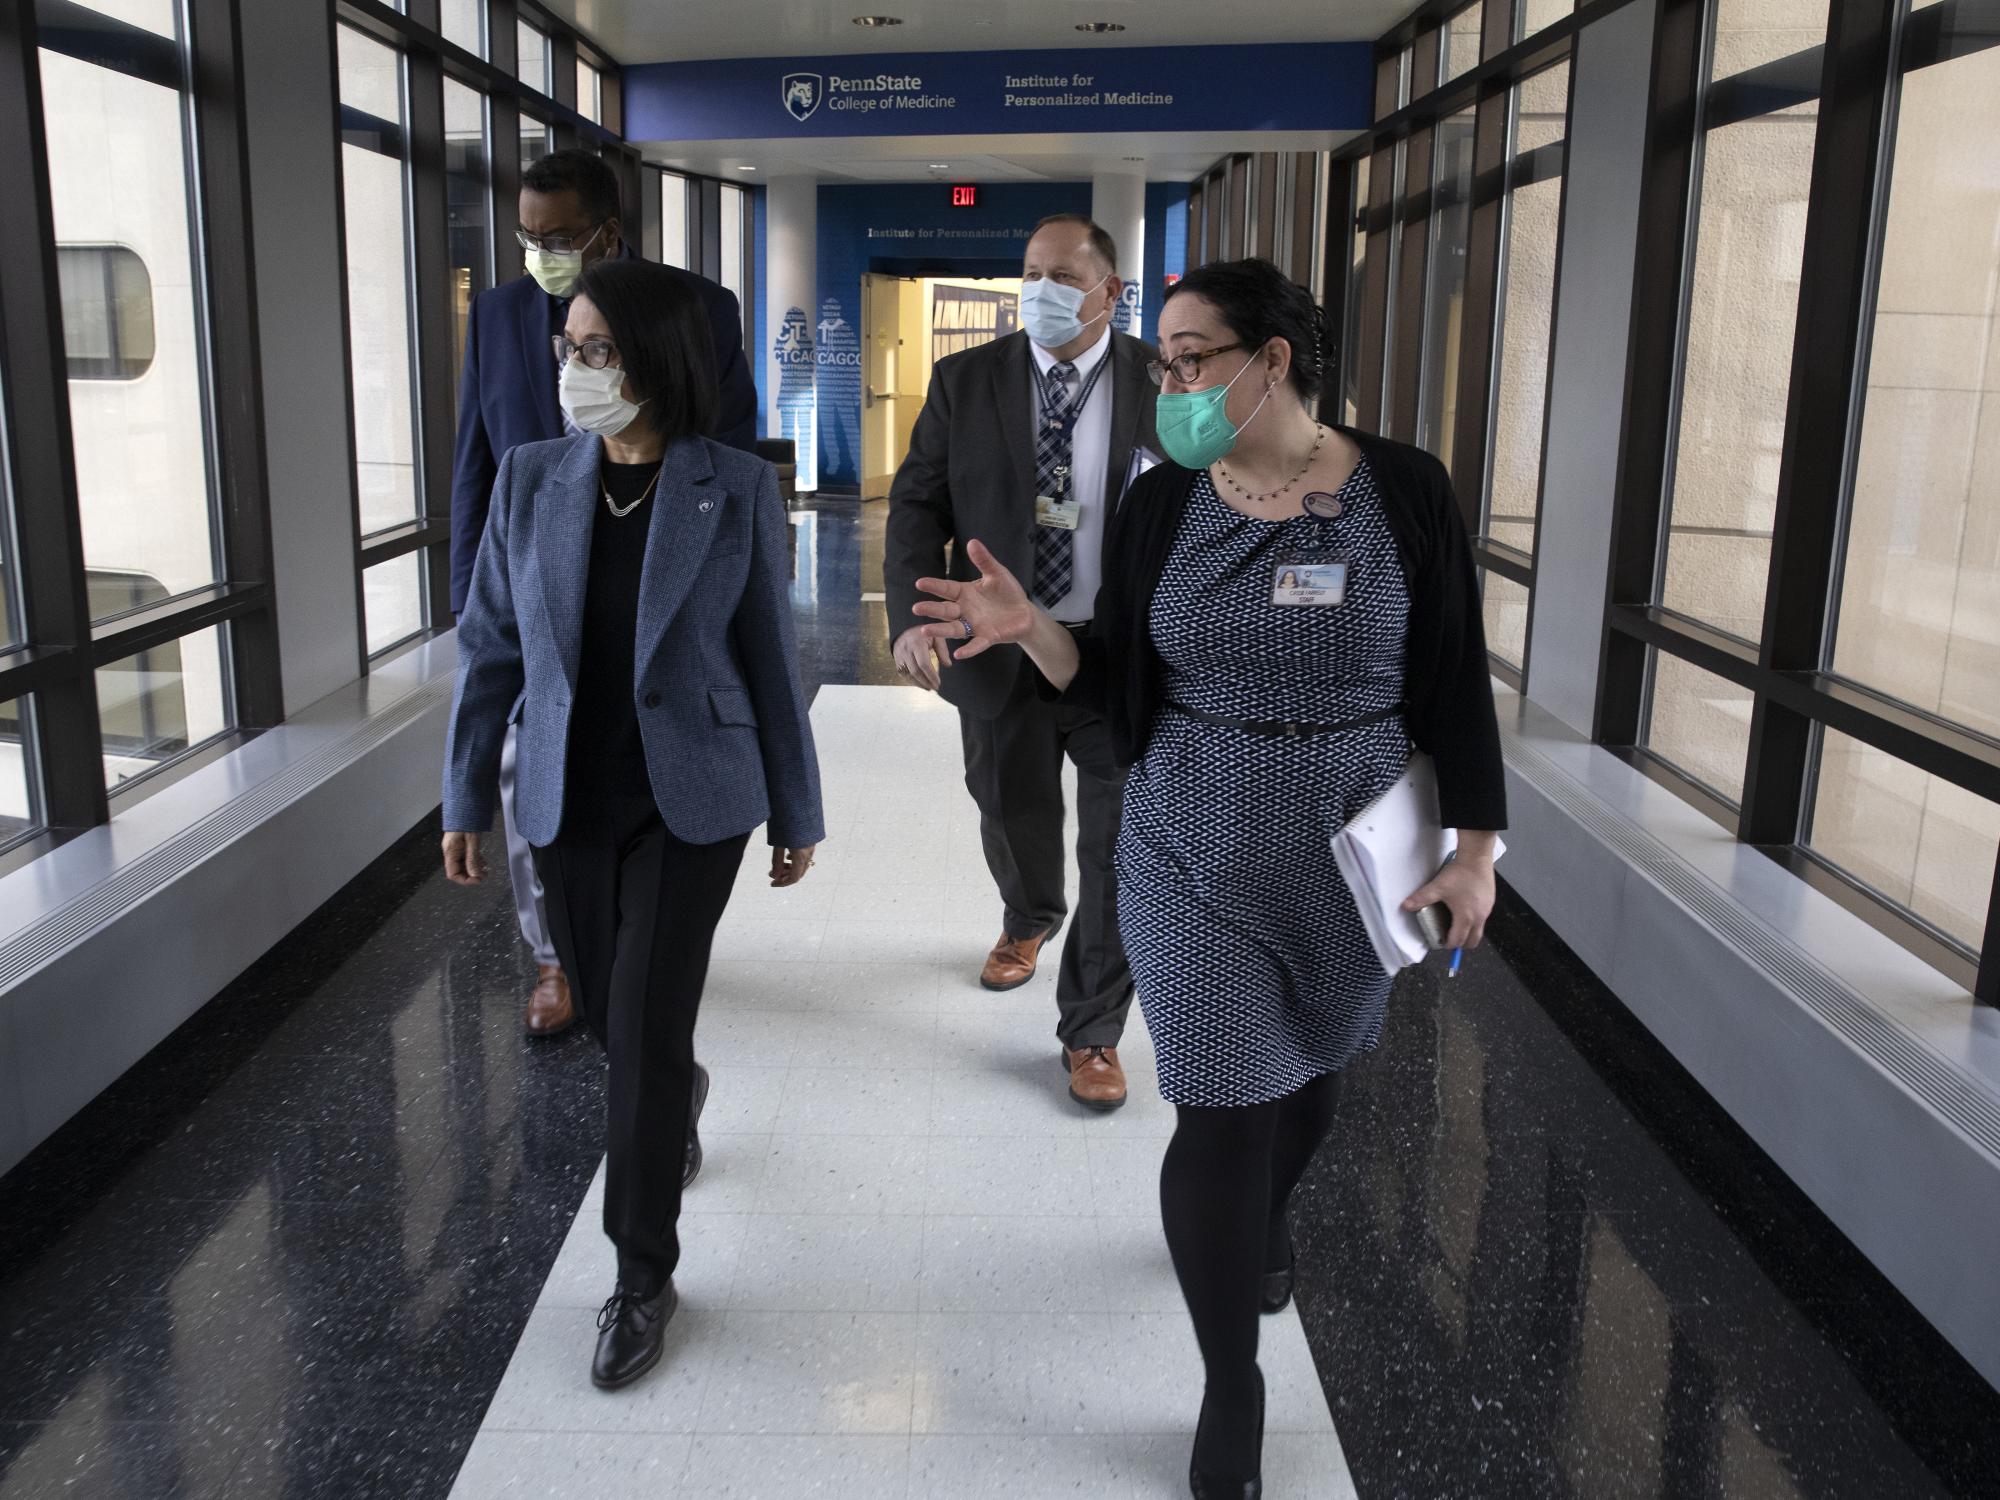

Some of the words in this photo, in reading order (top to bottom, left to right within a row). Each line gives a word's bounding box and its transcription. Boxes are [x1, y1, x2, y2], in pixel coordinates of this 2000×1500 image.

[829, 75, 922, 92] PennState
[1005, 75, 1068, 88] Institute
[1072, 74, 1094, 87] for
[829, 96, 876, 112] College
[880, 95, 894, 109] of
[896, 95, 956, 109] Medicine
[1005, 93, 1099, 106] Personalized
[1104, 92, 1173, 105] Medicine
[953, 187, 976, 205] EXIT
[868, 228, 915, 238] Institute
[918, 228, 934, 238] for
[937, 228, 1009, 238] Personalized
